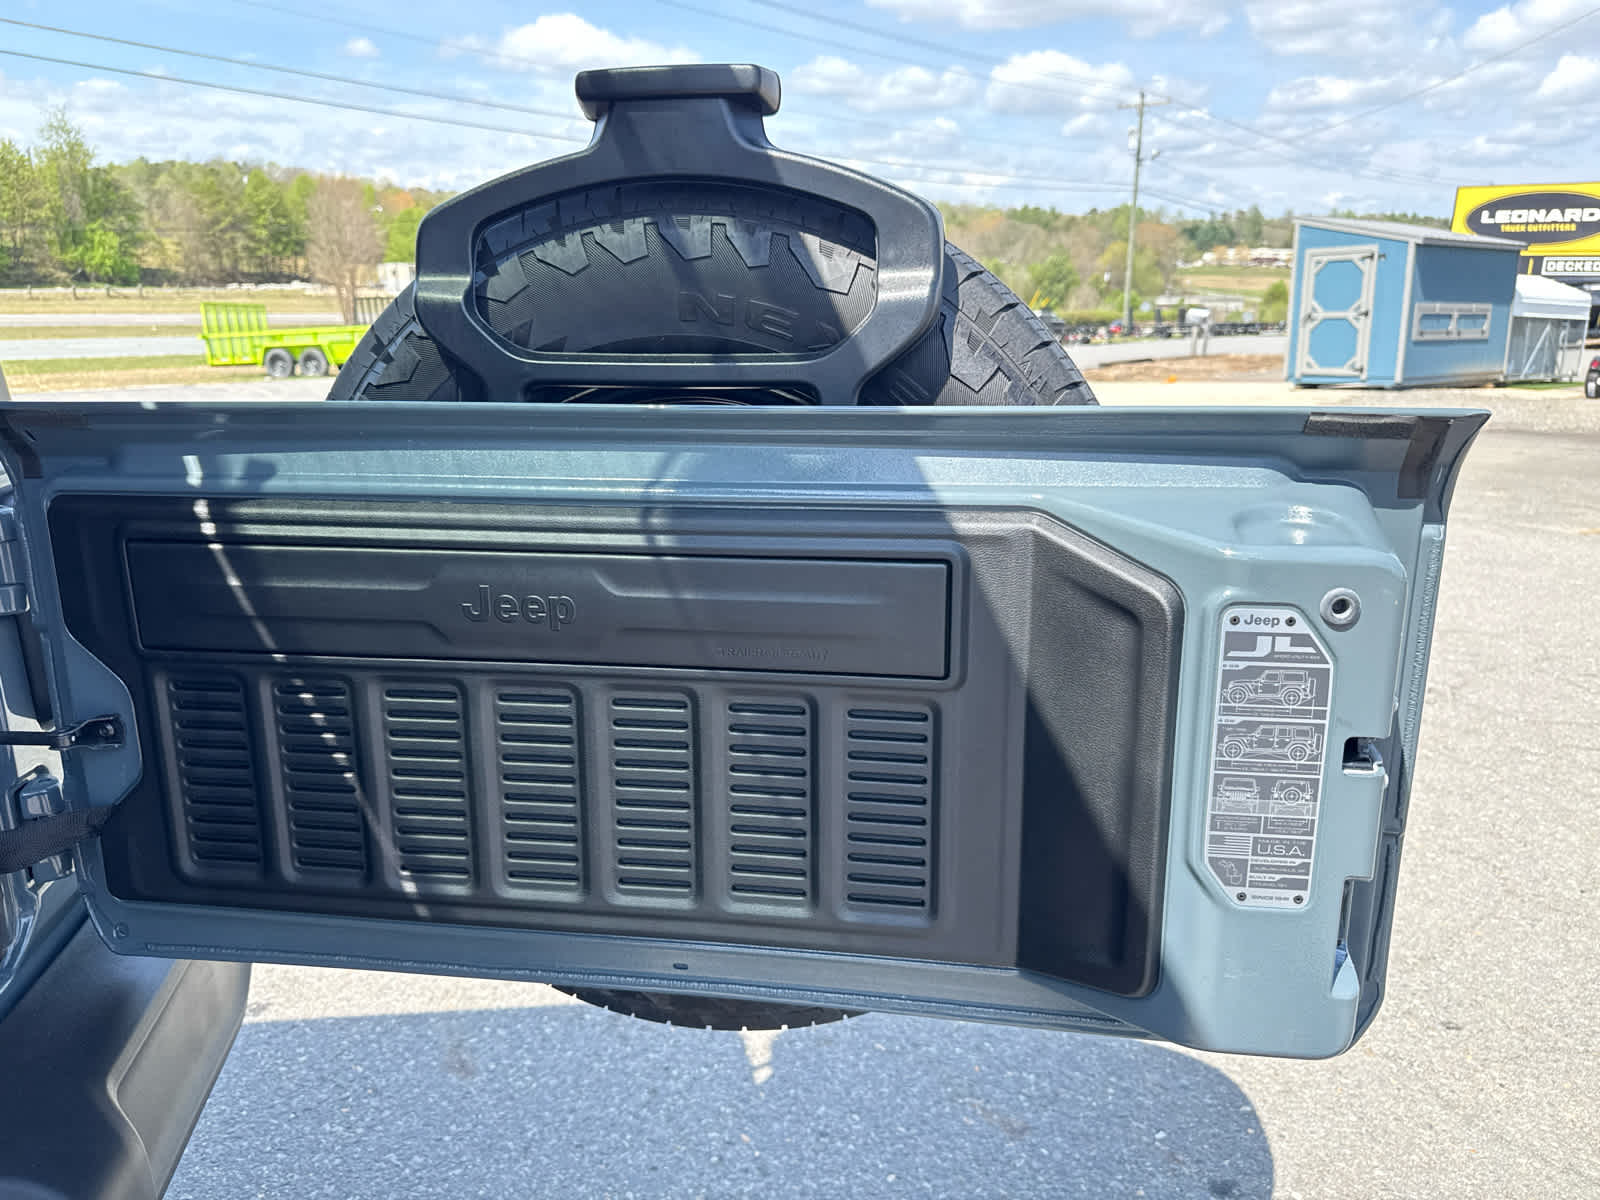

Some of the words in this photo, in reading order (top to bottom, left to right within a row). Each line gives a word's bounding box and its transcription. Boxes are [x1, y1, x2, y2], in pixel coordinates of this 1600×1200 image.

[1480, 207, 1600, 224] LEONARD
[1546, 260, 1600, 272] DECKED
[460, 584, 576, 632] Jeep
[1244, 614, 1281, 628] Jeep
[1226, 635, 1317, 657] JL
[1257, 843, 1305, 857] U.S.A.
